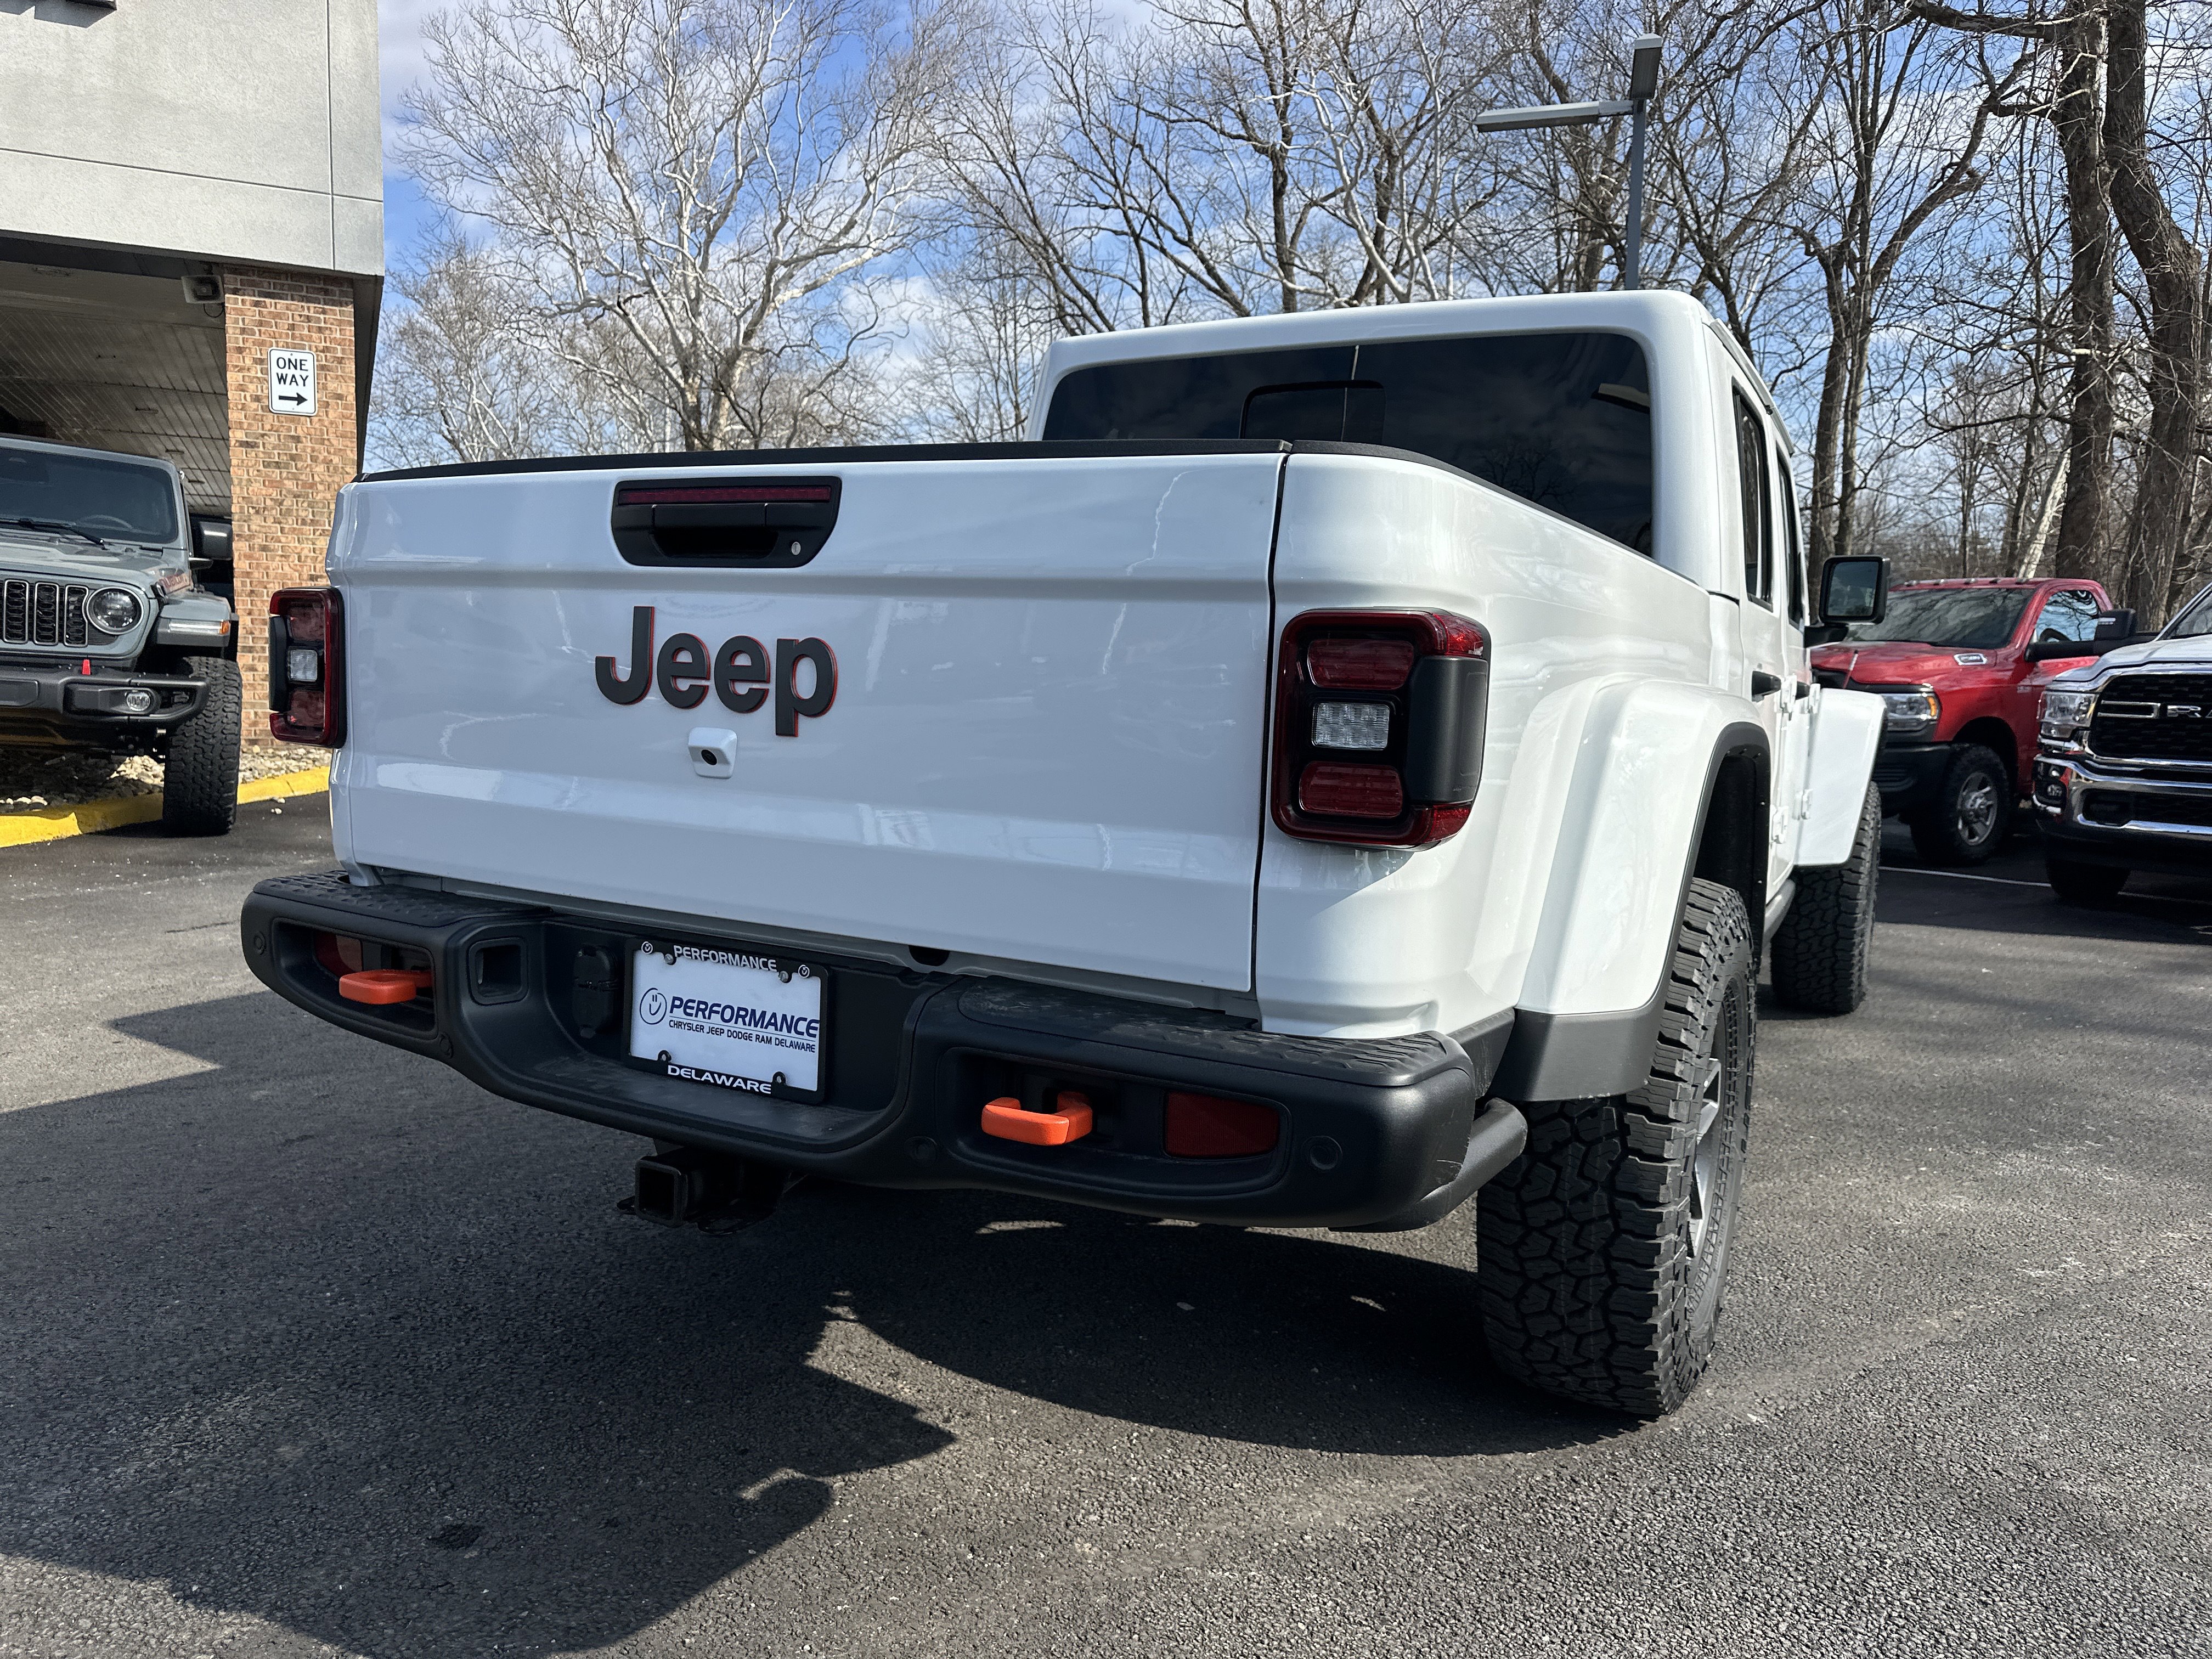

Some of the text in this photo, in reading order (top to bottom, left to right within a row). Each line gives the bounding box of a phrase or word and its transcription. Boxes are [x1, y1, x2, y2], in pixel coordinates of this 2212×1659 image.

[276, 357, 308, 371] ONE
[276, 373, 309, 387] WAY
[595, 606, 838, 737] Jeep
[673, 945, 777, 972] PERFORMANCE
[669, 996, 820, 1037] PERFORMANCE
[669, 1019, 816, 1053] CHRYSLER JEEP DODGE RAM DELAWARE
[667, 1065, 772, 1094] DELAWARE
